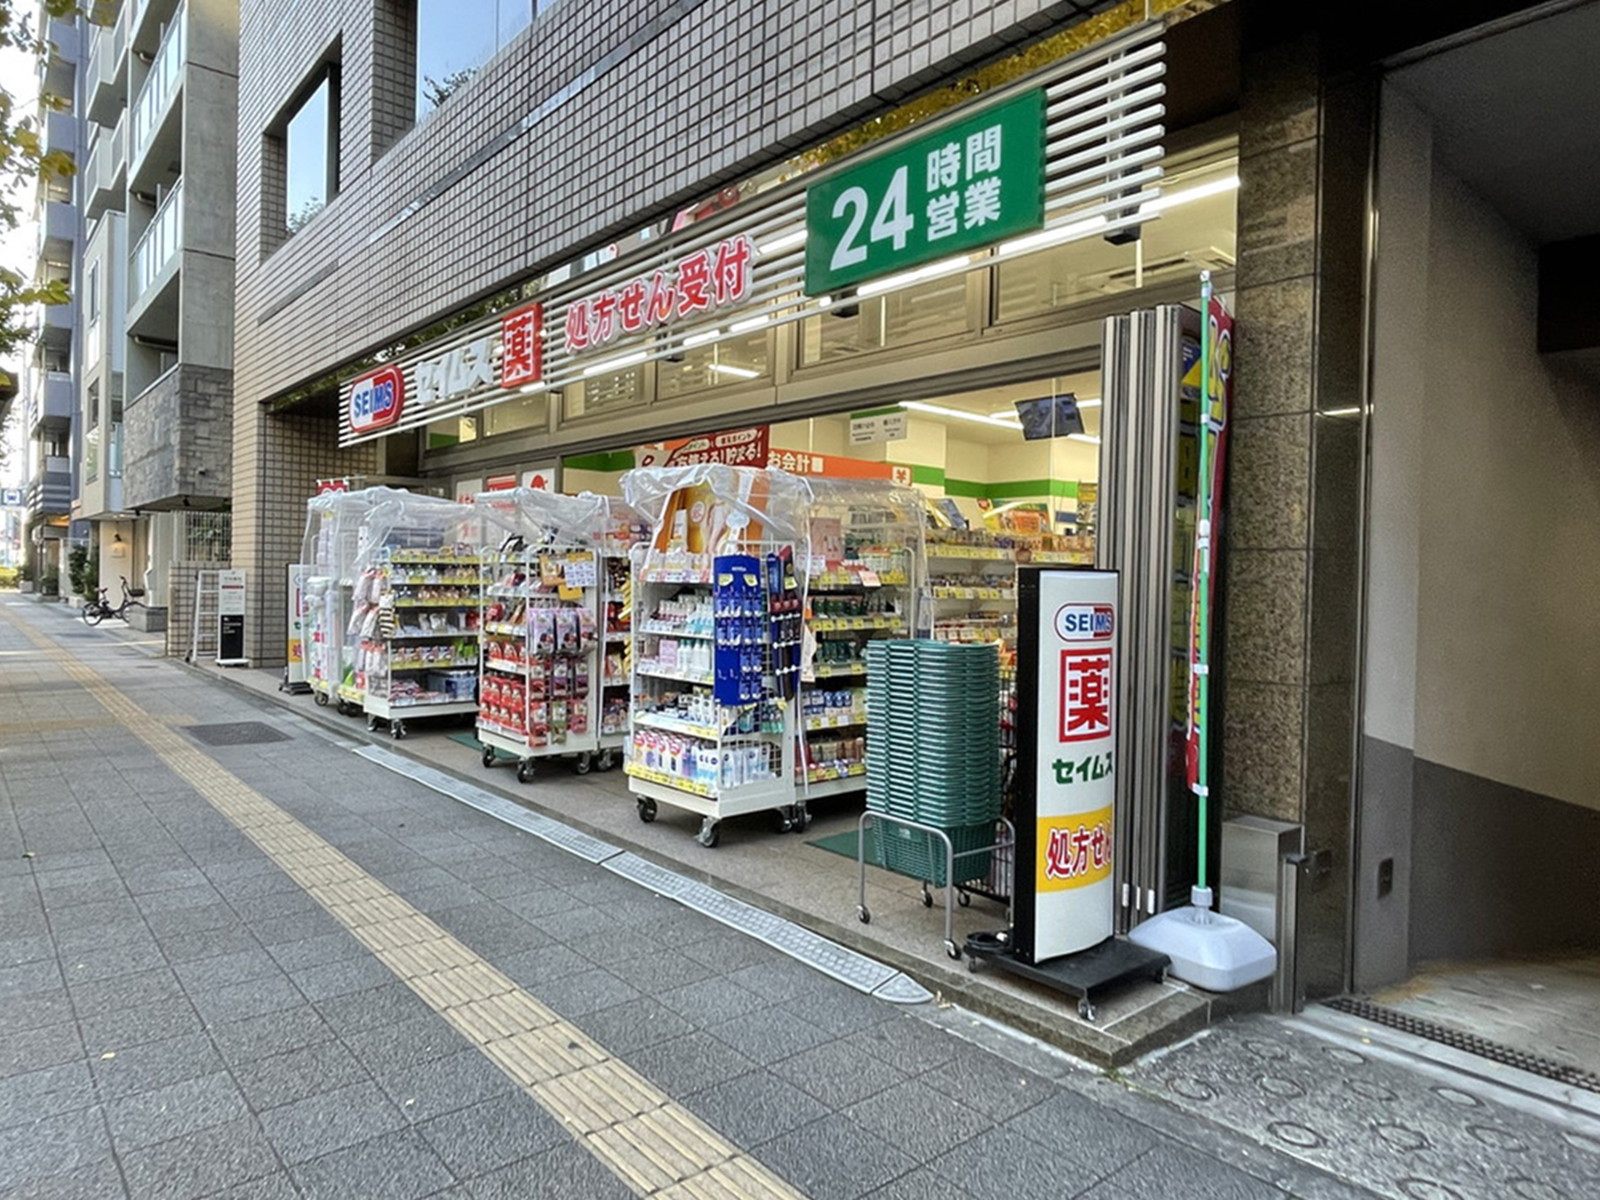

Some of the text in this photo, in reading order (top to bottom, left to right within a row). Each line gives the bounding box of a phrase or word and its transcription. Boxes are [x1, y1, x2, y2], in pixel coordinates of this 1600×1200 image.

[926, 123, 1002, 193] 時間
[830, 165, 914, 272] 24
[926, 176, 1002, 242] 営業
[565, 236, 750, 352] 処方せん受付
[415, 338, 494, 405] セイムス
[505, 312, 534, 384] 薬
[354, 381, 394, 418] SEIMS
[1064, 612, 1112, 632] SEIMS
[1066, 657, 1110, 732] 薬
